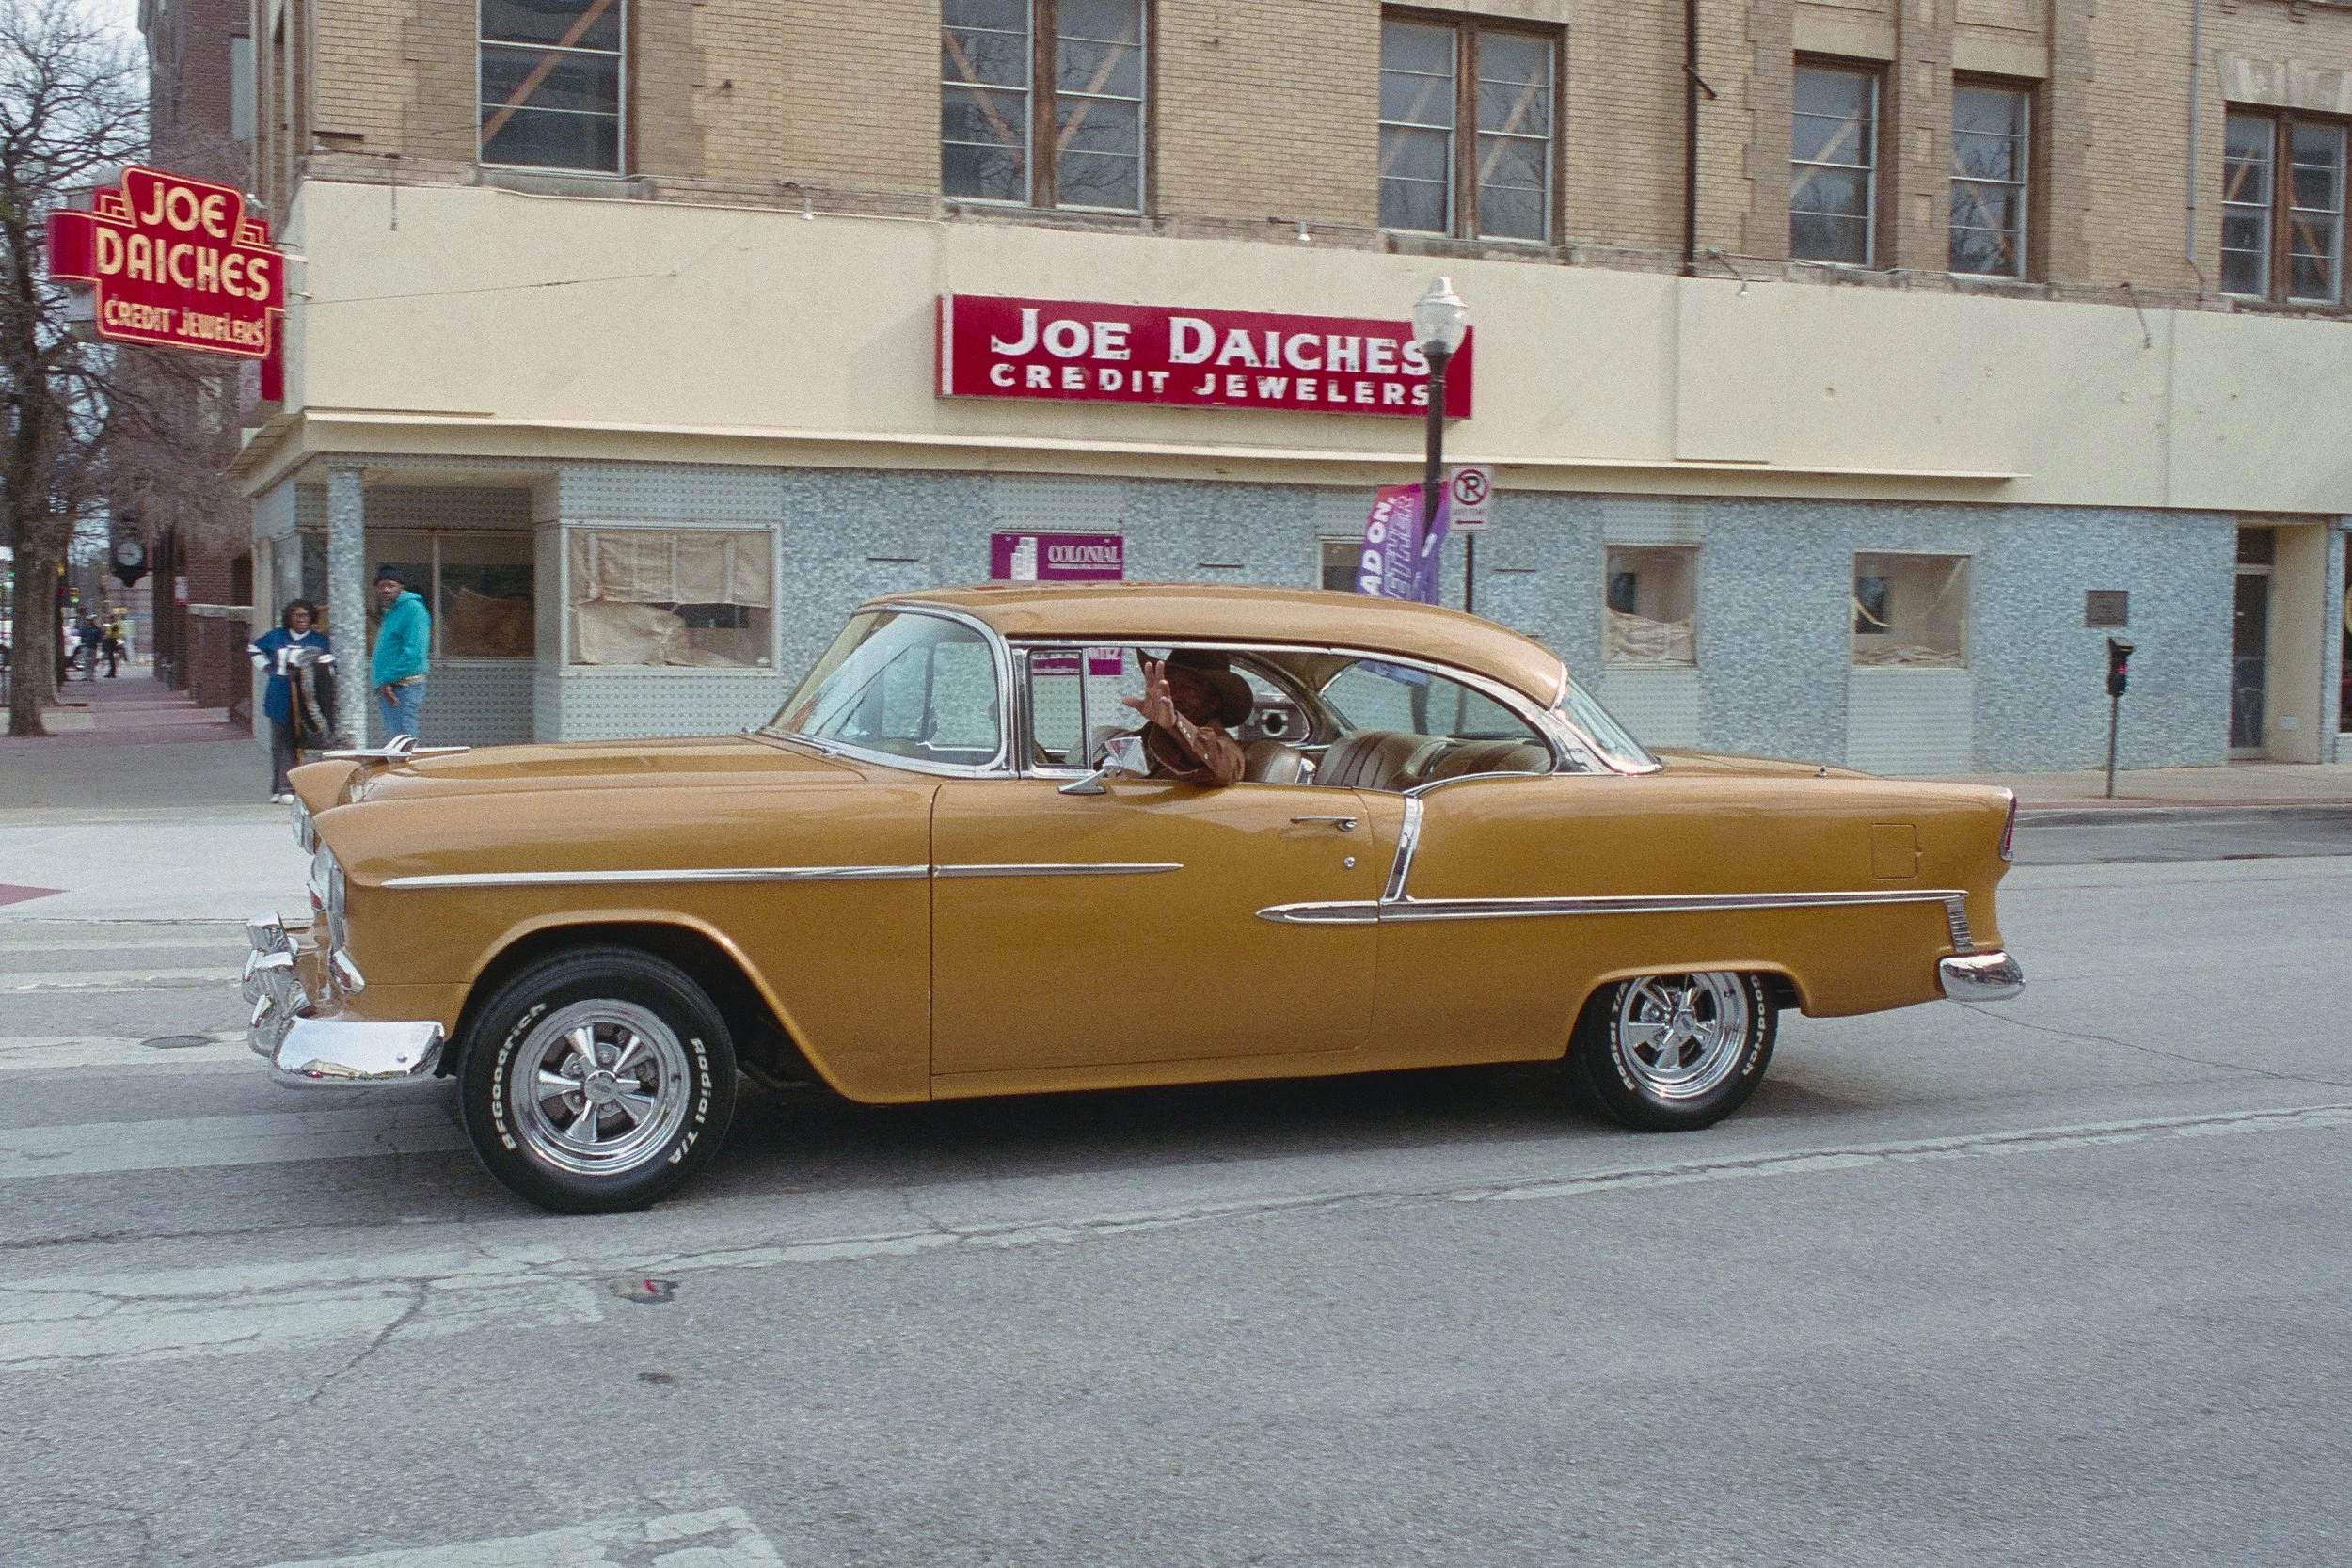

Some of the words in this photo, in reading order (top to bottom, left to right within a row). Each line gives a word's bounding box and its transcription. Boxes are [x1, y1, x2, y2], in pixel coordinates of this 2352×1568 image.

[141, 182, 228, 238] JOE
[96, 226, 271, 301] DAICHES
[104, 296, 176, 333] CREDIT
[176, 309, 265, 347] JEWELERS
[991, 308, 1131, 361] JOE
[1168, 316, 1432, 376] DAICHES
[989, 363, 1170, 394] CREDIT
[1191, 373, 1430, 406] JEWELERS
[1048, 546, 1121, 563] COLONIAL
[491, 1003, 547, 1150] BFGoodrich
[691, 1037, 712, 1124] Radial
[667, 1131, 699, 1164] T/A
